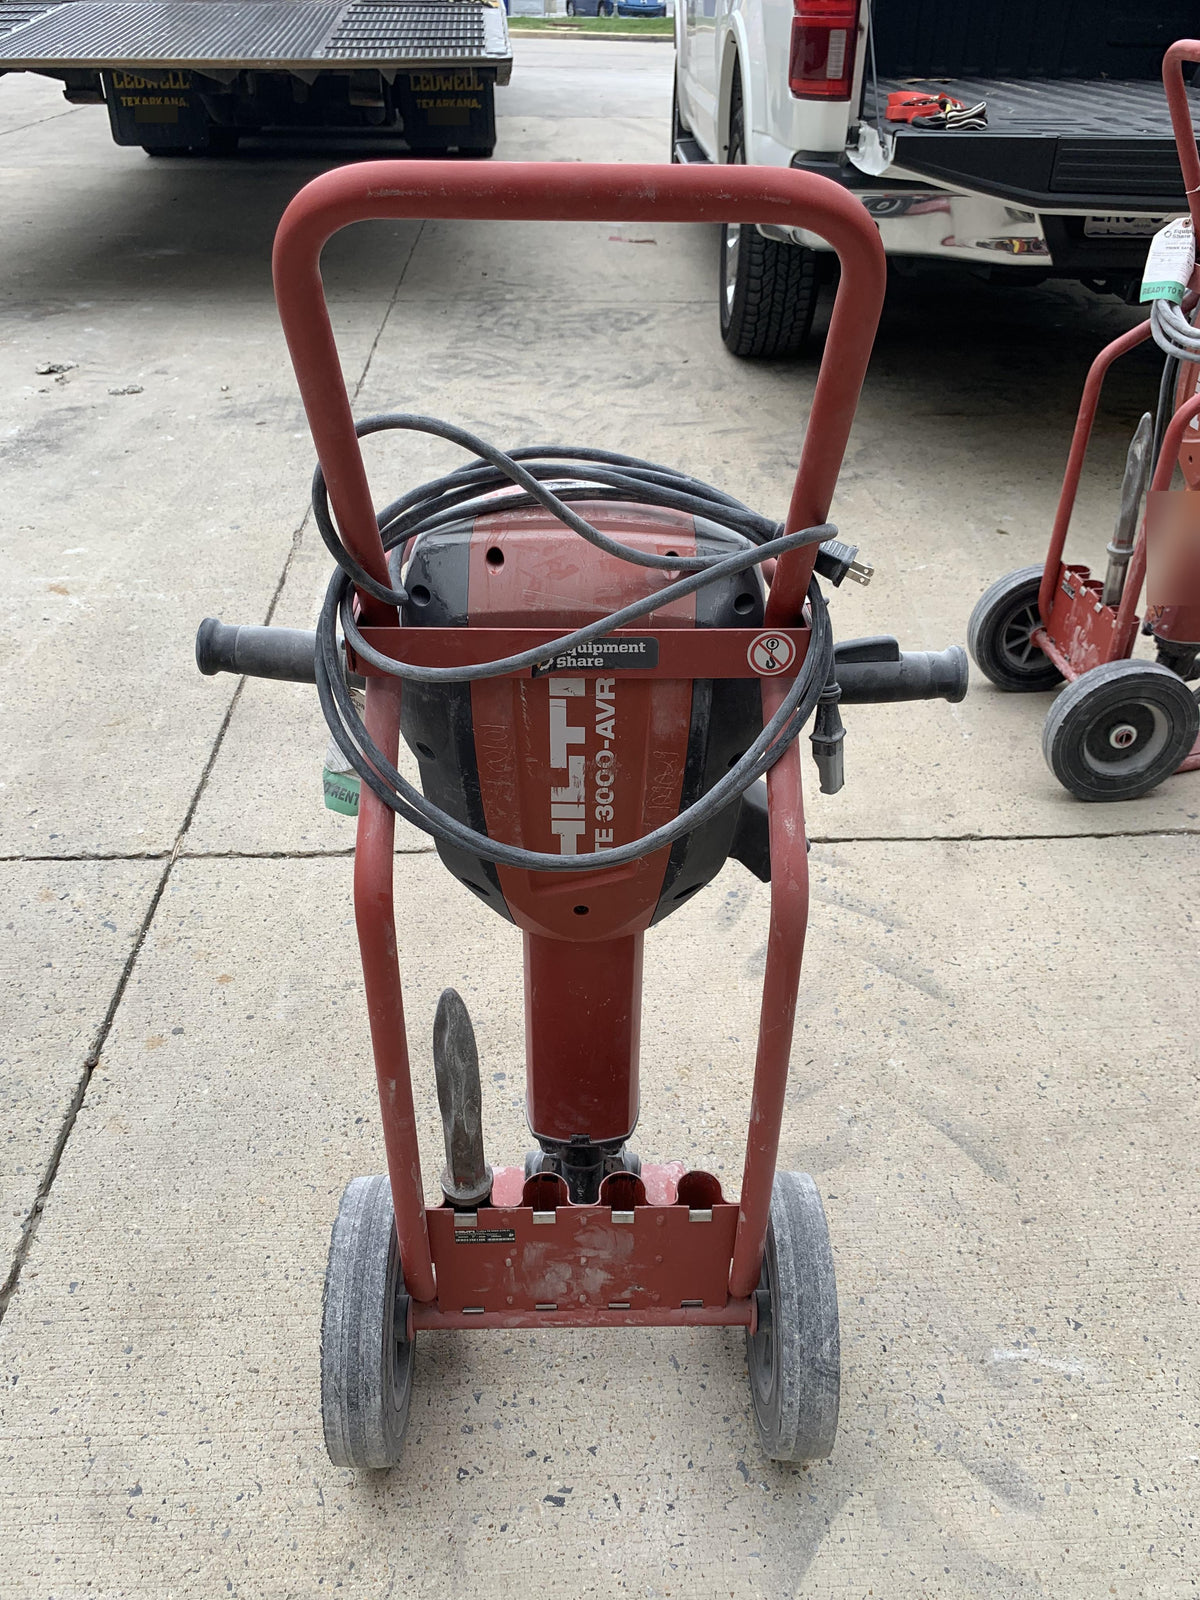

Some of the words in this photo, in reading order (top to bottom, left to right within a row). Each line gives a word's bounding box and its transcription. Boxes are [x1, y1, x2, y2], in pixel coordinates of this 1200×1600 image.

[409, 73, 484, 91] LEDWELL
[560, 642, 646, 656] quipment
[556, 657, 604, 668] Share
[594, 678, 616, 822] 3000-AVR
[549, 678, 586, 856] HILTI
[331, 784, 360, 806] RENT
